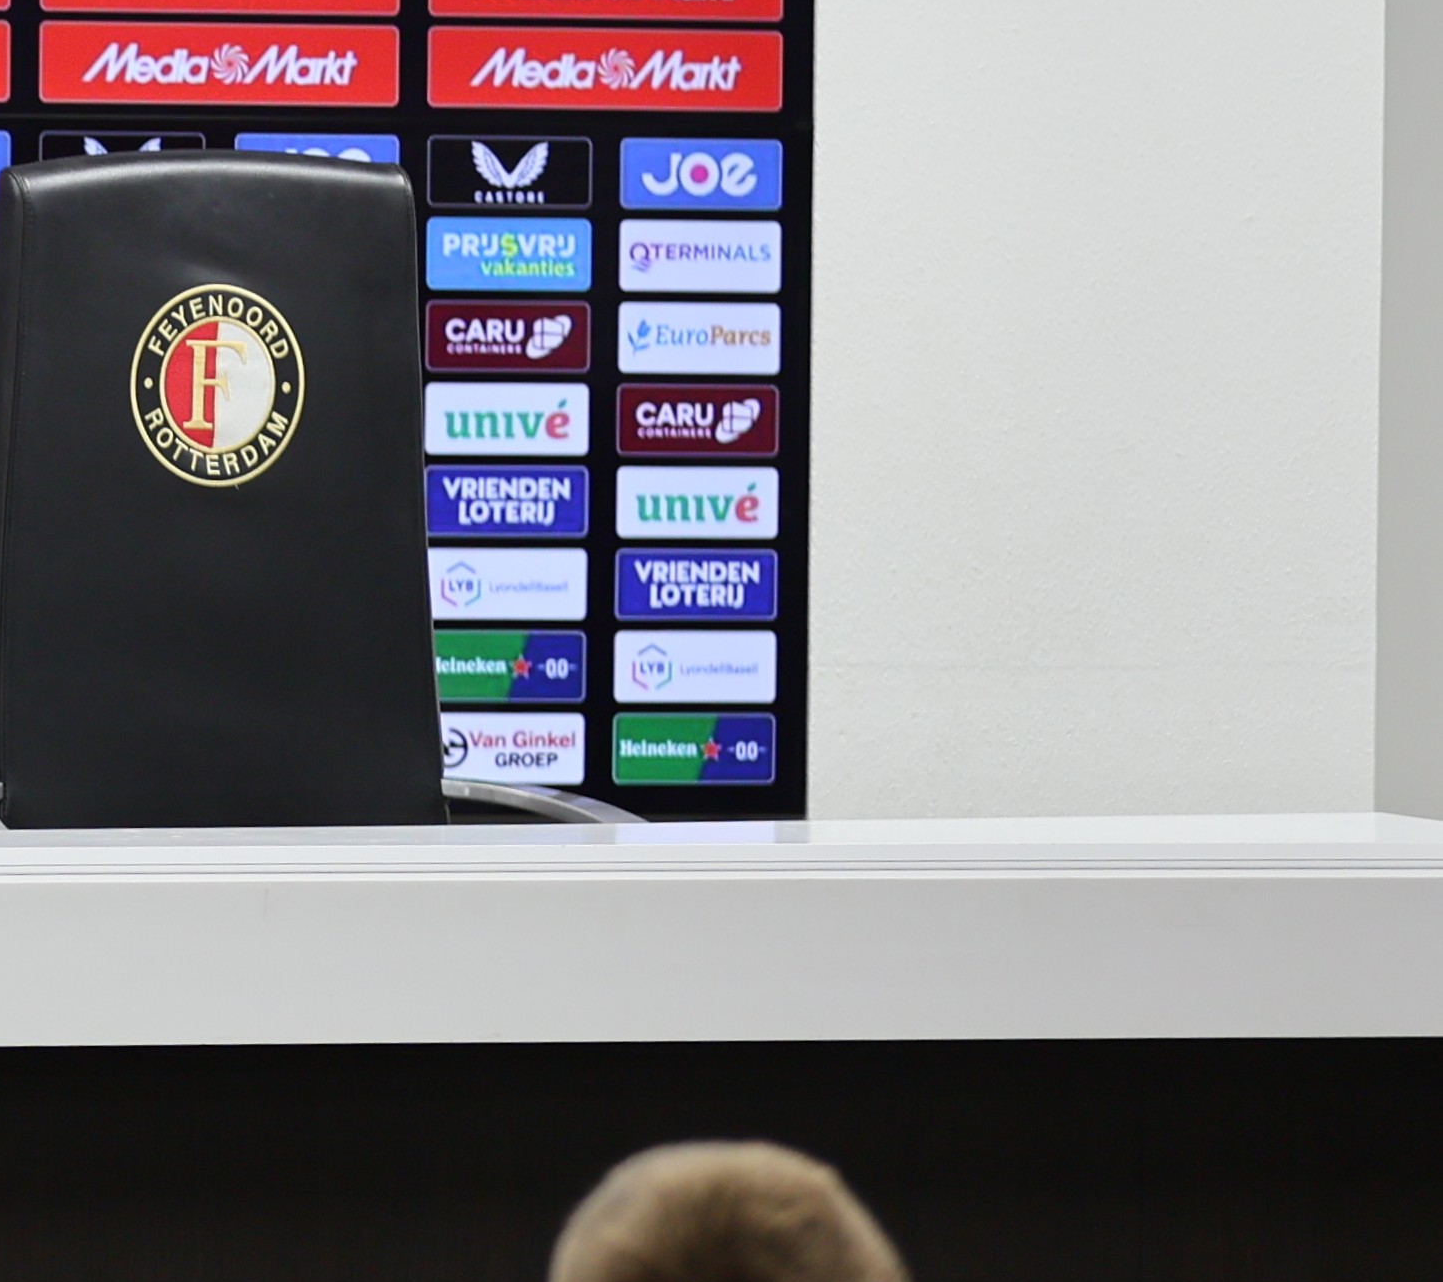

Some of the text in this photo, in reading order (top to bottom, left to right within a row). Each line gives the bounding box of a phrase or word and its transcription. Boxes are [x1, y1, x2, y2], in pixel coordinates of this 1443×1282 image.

[639, 150, 757, 194] JOE
[473, 191, 542, 203] CASTORE
[627, 241, 770, 264] QTERMINALS
[479, 258, 573, 276] vakanties
[147, 294, 290, 359] FEYENOORD
[444, 319, 523, 342] CARU
[654, 324, 771, 345] EuroParcs
[443, 398, 569, 438] univé
[635, 402, 714, 426] CARU
[144, 407, 289, 476] ROTTERDAM
[441, 478, 570, 499] VRIENDEN
[456, 501, 554, 525] LOTERIJ
[635, 482, 760, 521] univé
[632, 561, 761, 582] VRIENDEN
[647, 584, 744, 608] LOTERIJ
[469, 730, 576, 747] Van Ginkel
[621, 740, 699, 756] Heineken
[495, 753, 559, 766] GROEP
